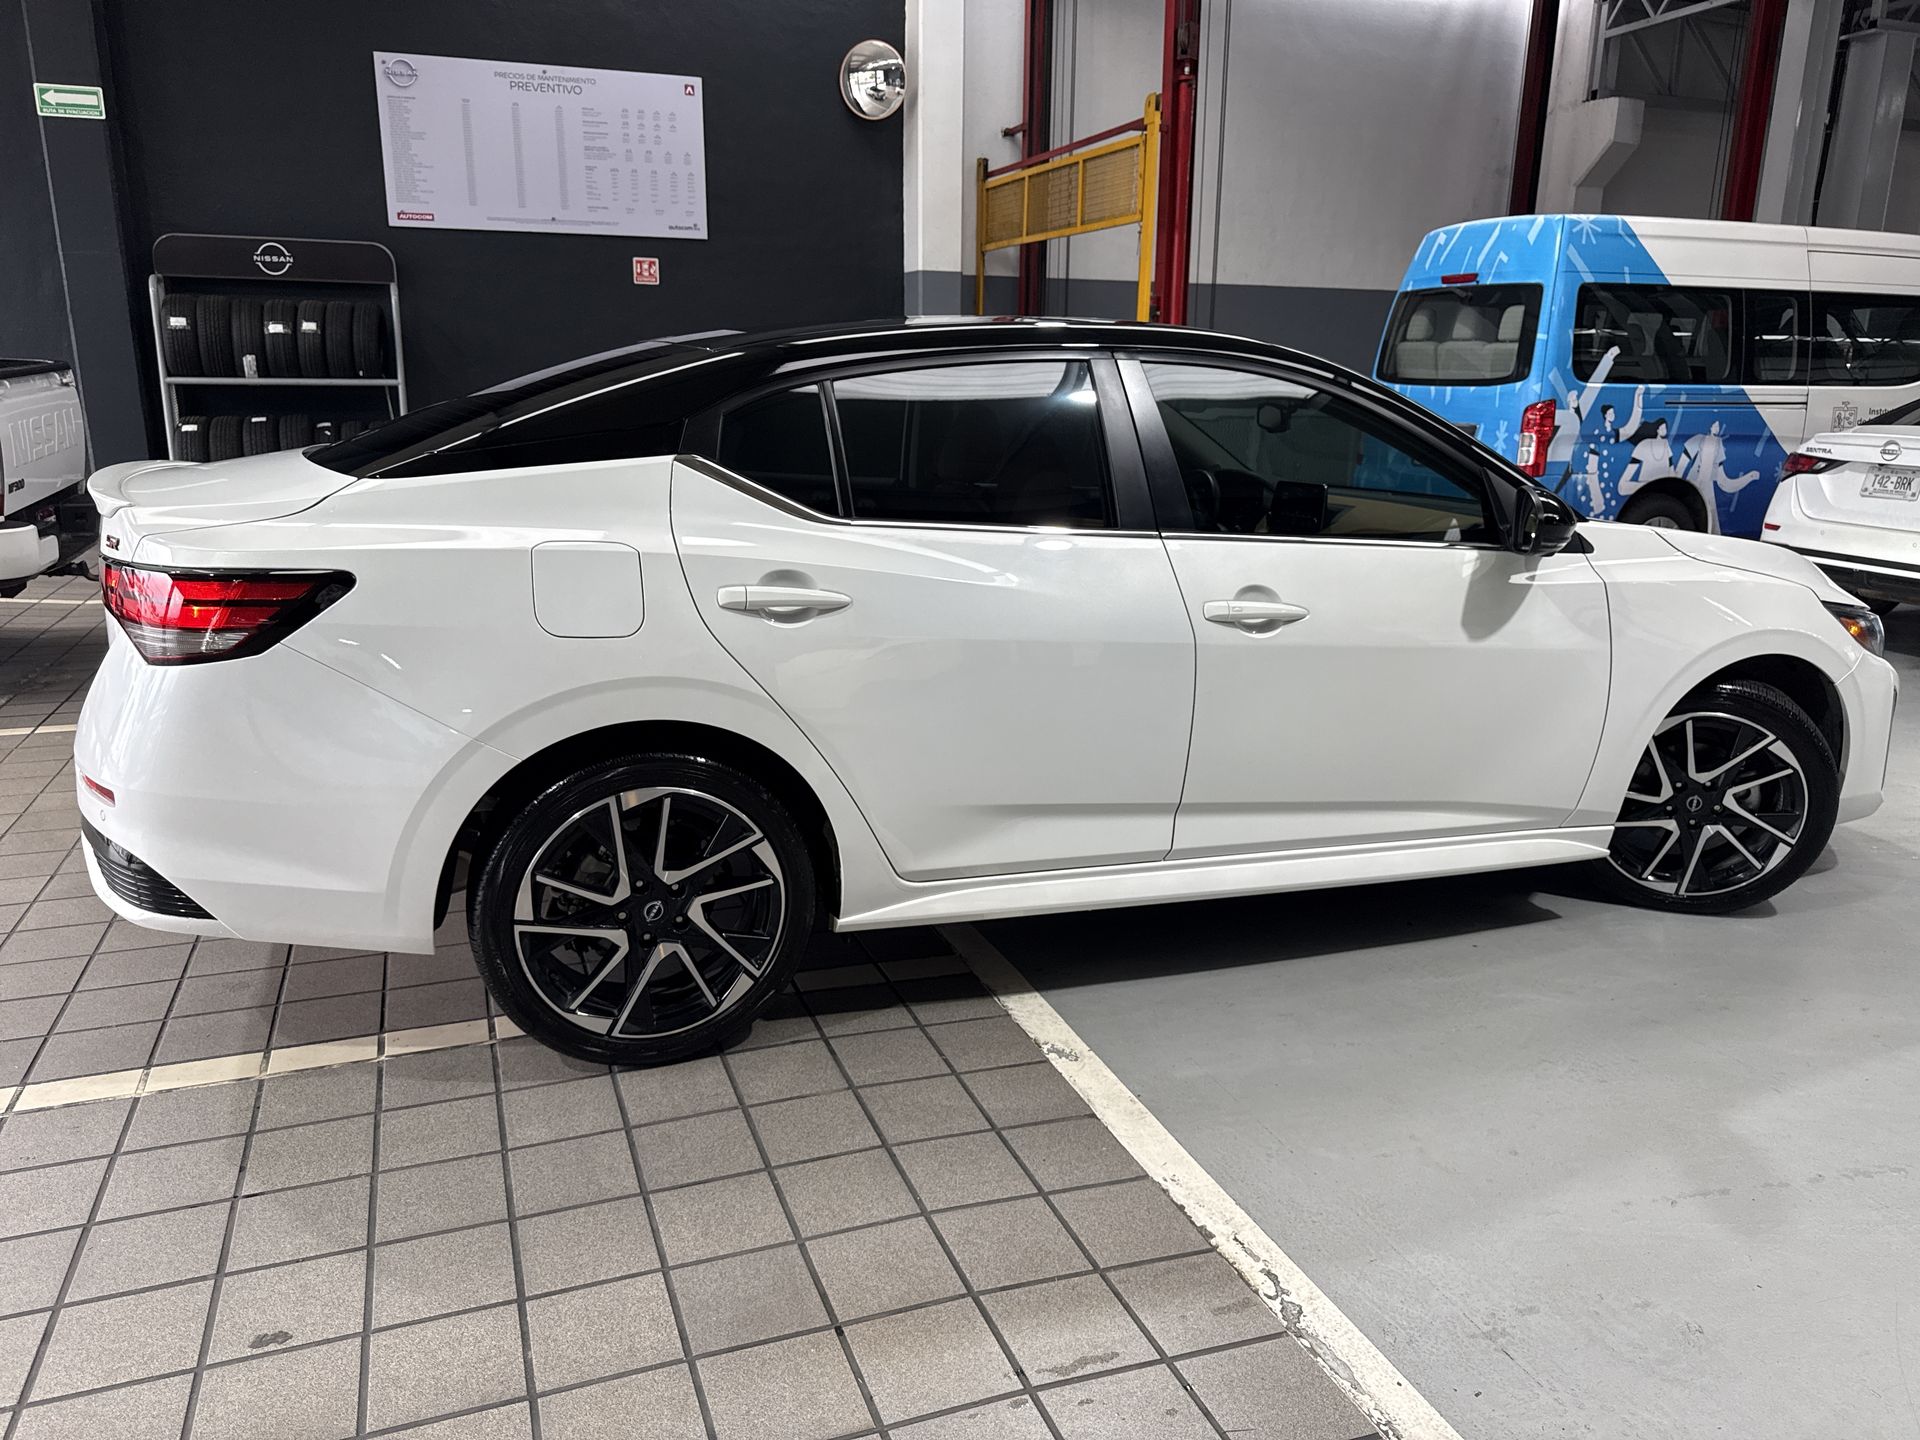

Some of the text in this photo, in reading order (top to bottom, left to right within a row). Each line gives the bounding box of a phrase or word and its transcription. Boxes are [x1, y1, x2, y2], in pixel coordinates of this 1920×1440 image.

[494, 71, 597, 86] PRECIOS DE MANTENIMIENTO
[509, 81, 583, 95] PREVENTIVO
[8, 407, 80, 468] NISSAN
[1805, 446, 1833, 455] SENTRA
[1871, 474, 1915, 491] T42-BRK
